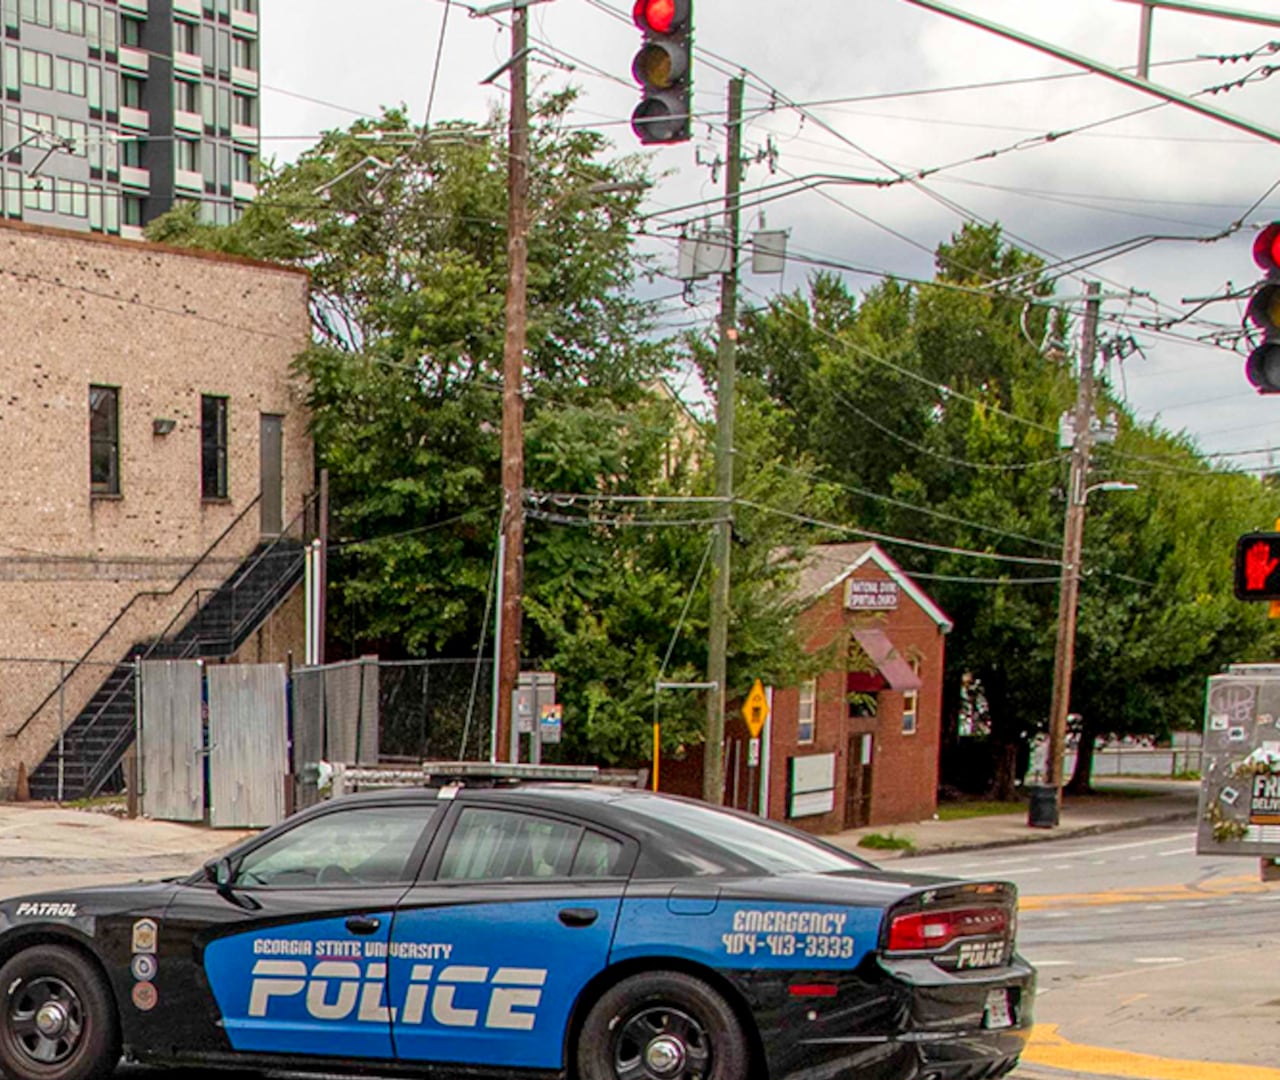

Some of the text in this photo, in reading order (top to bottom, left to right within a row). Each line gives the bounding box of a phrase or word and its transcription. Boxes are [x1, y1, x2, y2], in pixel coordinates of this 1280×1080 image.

[16, 902, 78, 917] PATROL
[732, 911, 847, 935] EMERGENCY
[253, 939, 454, 960] GEORGIA STATE UNIVERSITY
[722, 933, 855, 959] 404-413-3333
[957, 941, 1005, 970] POLICE
[247, 958, 549, 1031] POLICE
